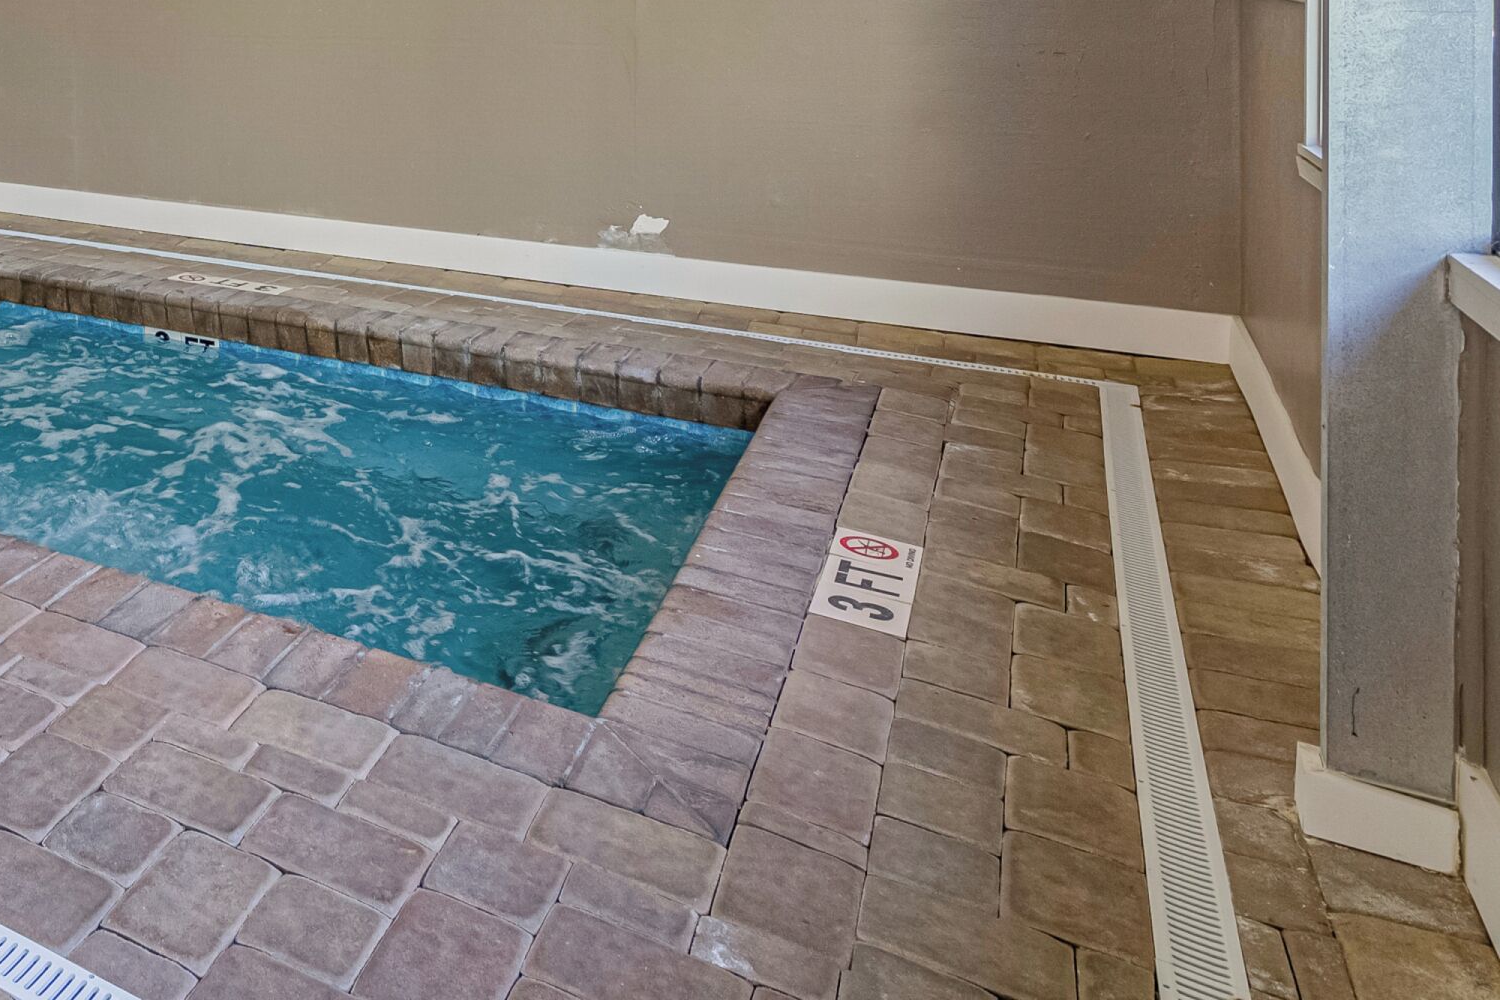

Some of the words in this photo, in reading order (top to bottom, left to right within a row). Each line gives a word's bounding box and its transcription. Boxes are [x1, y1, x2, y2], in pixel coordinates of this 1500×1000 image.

[210, 279, 248, 288] FT
[834, 559, 903, 597] FT
[828, 595, 894, 621] 3
